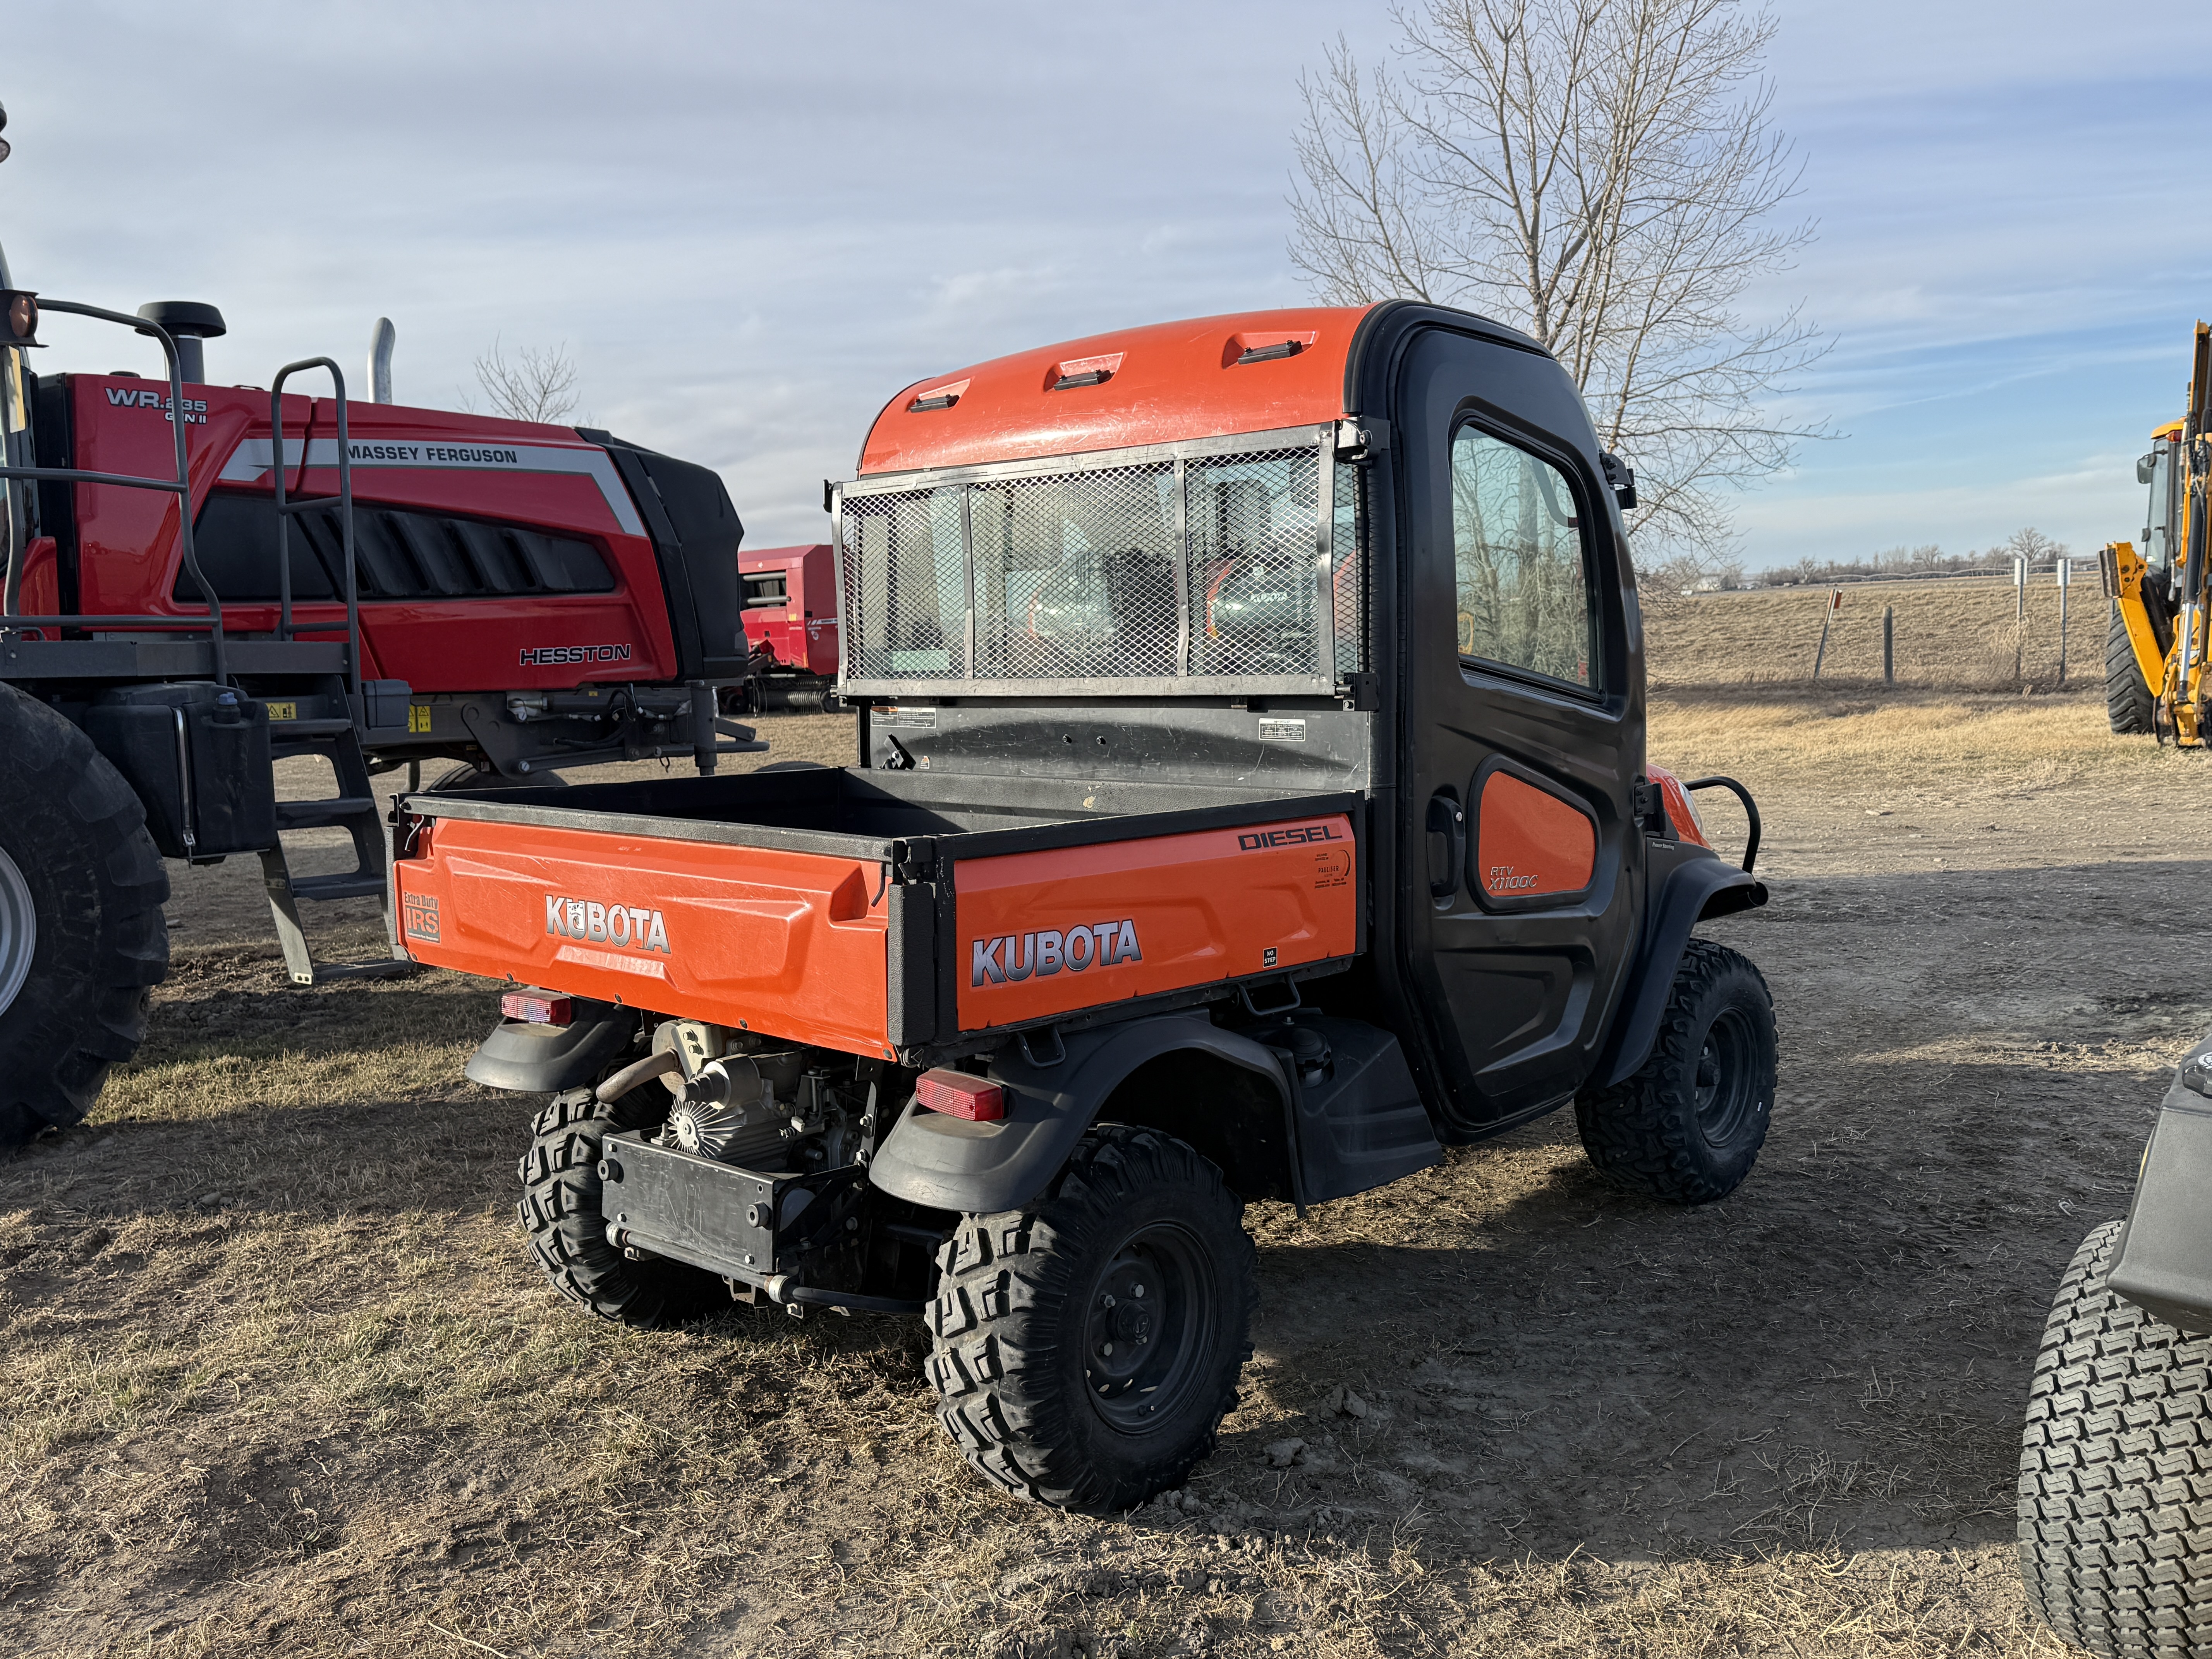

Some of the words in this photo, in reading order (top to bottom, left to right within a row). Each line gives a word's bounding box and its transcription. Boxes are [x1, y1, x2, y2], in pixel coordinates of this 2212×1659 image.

[105, 387, 207, 412] WR.235
[165, 412, 195, 422] GN
[348, 445, 419, 460] MASSEY
[426, 448, 517, 463] FERGUSON
[520, 644, 631, 666] HESSTON
[1238, 825, 1343, 851] DIESEL
[1490, 866, 1514, 876] RTV
[1488, 875, 1538, 890] X1100C
[404, 891, 421, 906] Extra
[421, 895, 438, 909] Duty
[406, 907, 438, 934] IRS
[545, 894, 671, 954] KUBOTA
[972, 919, 1142, 987] KUBOTA
